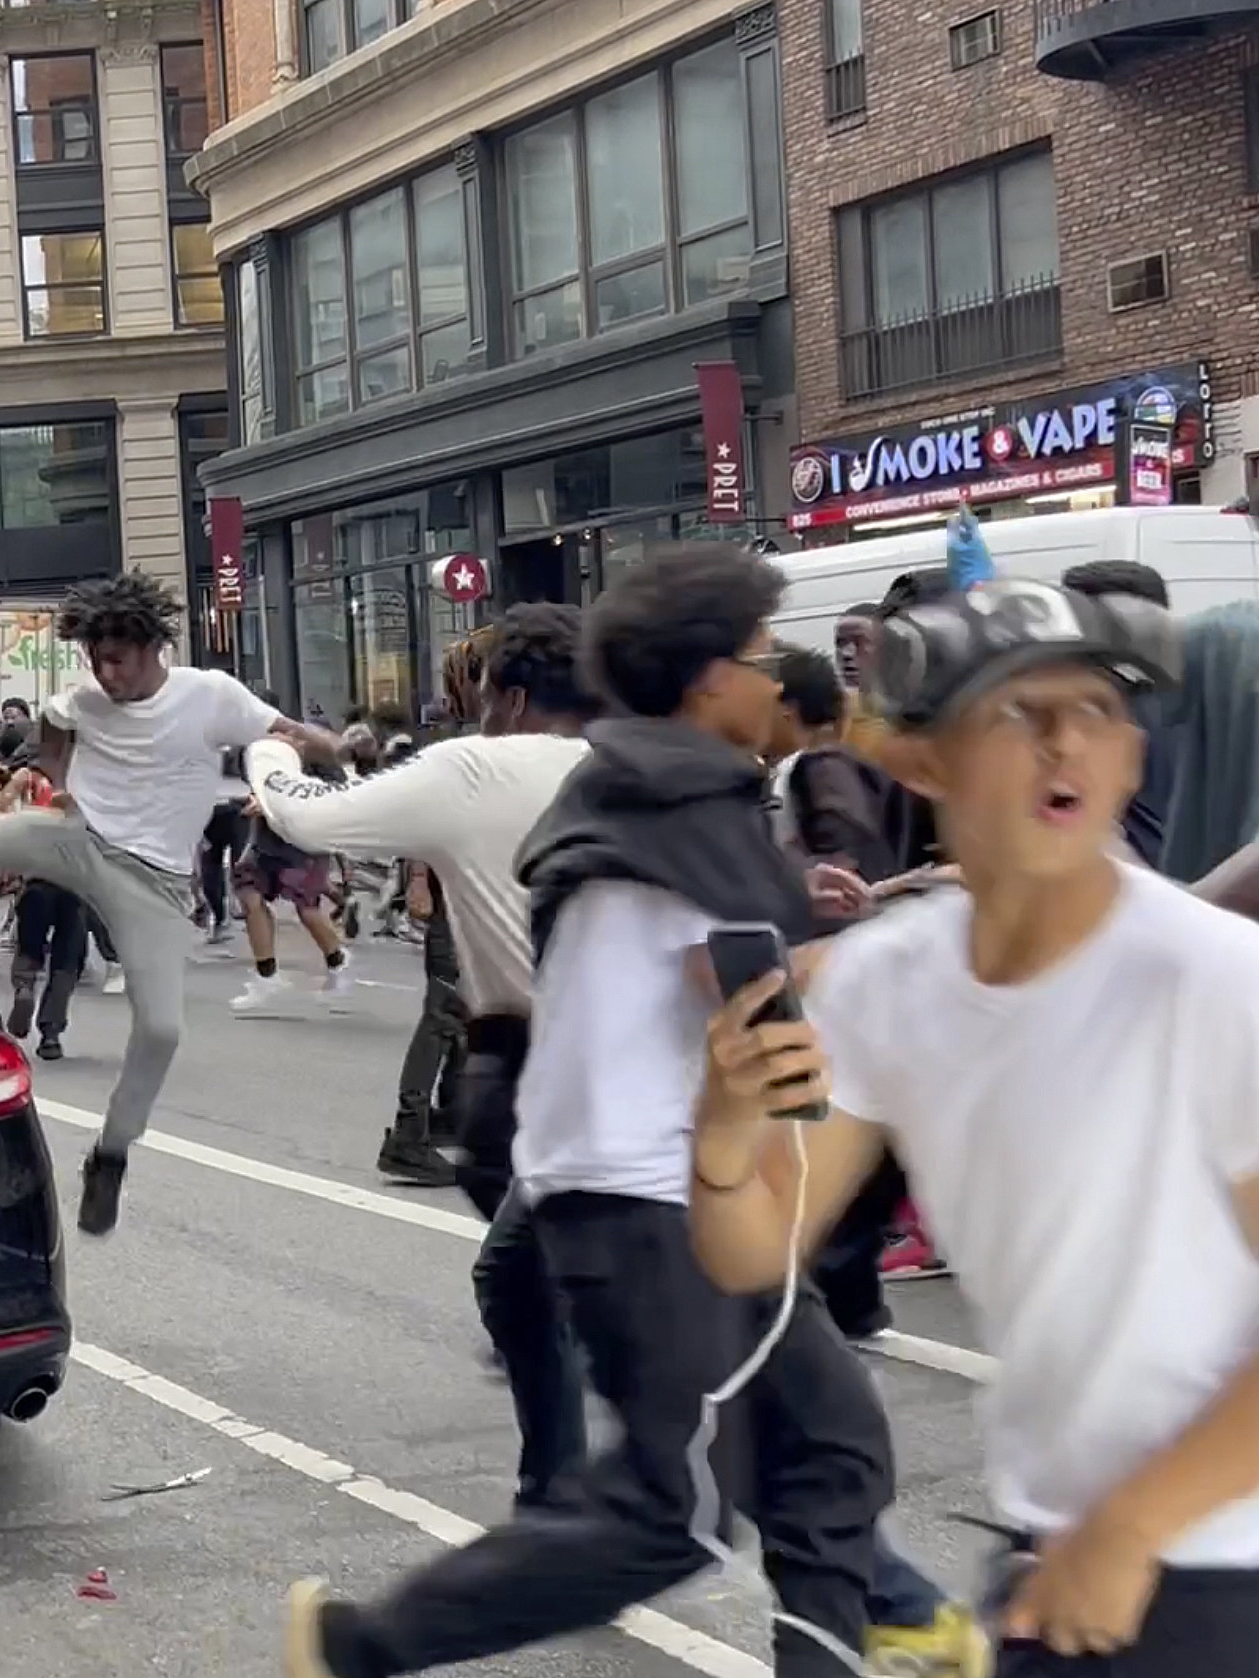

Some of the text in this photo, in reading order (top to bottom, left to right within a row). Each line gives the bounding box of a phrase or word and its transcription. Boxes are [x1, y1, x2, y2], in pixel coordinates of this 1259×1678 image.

[830, 453, 841, 494] I
[849, 425, 981, 492] SMOKE
[993, 429, 1010, 454] &
[1016, 397, 1116, 459] VAPE
[712, 463, 739, 512] PRET
[845, 496, 920, 519] CONVENIENCE
[970, 473, 1040, 496] MAGAZINES
[1042, 470, 1052, 484] &
[218, 568, 241, 602] PRET
